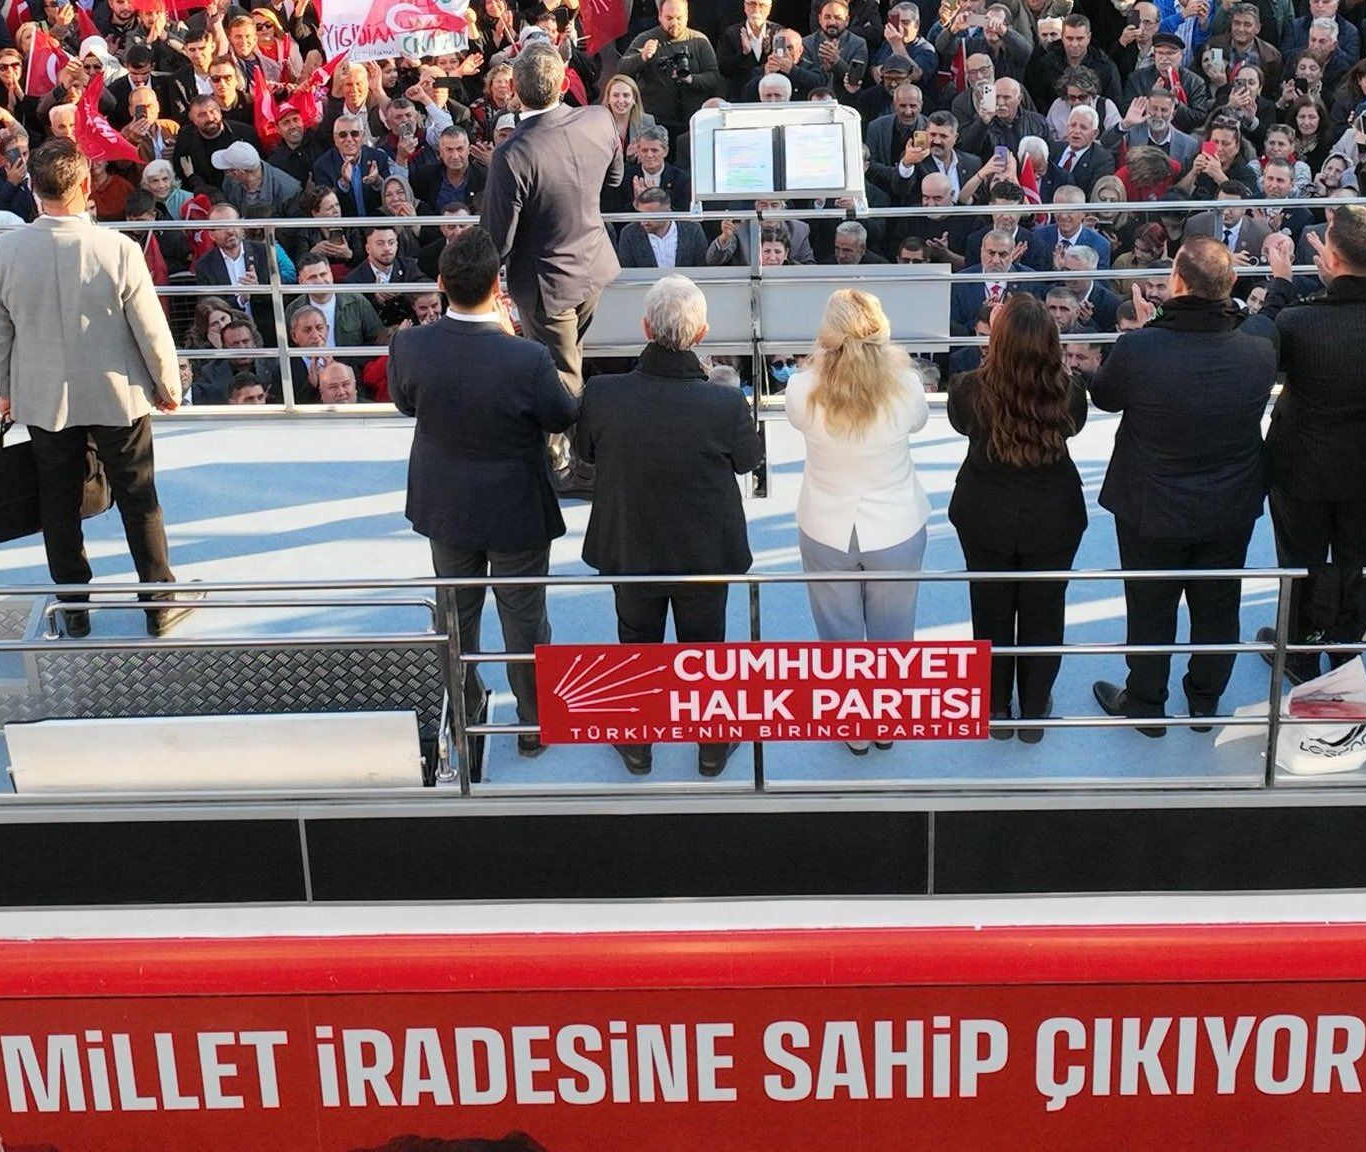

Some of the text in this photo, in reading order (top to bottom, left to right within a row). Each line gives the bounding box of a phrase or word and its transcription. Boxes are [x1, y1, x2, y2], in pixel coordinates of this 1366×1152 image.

[672, 646, 970, 683] CUMHURİYET
[668, 686, 982, 723] HALK PARTİSİ
[569, 723, 984, 742] TÜRKİYE'NİN BİRİNCİ PARTİSİ
[1, 1014, 1366, 1113] MİLLET İRADESİNE SAHİP ÇIKIYOR
